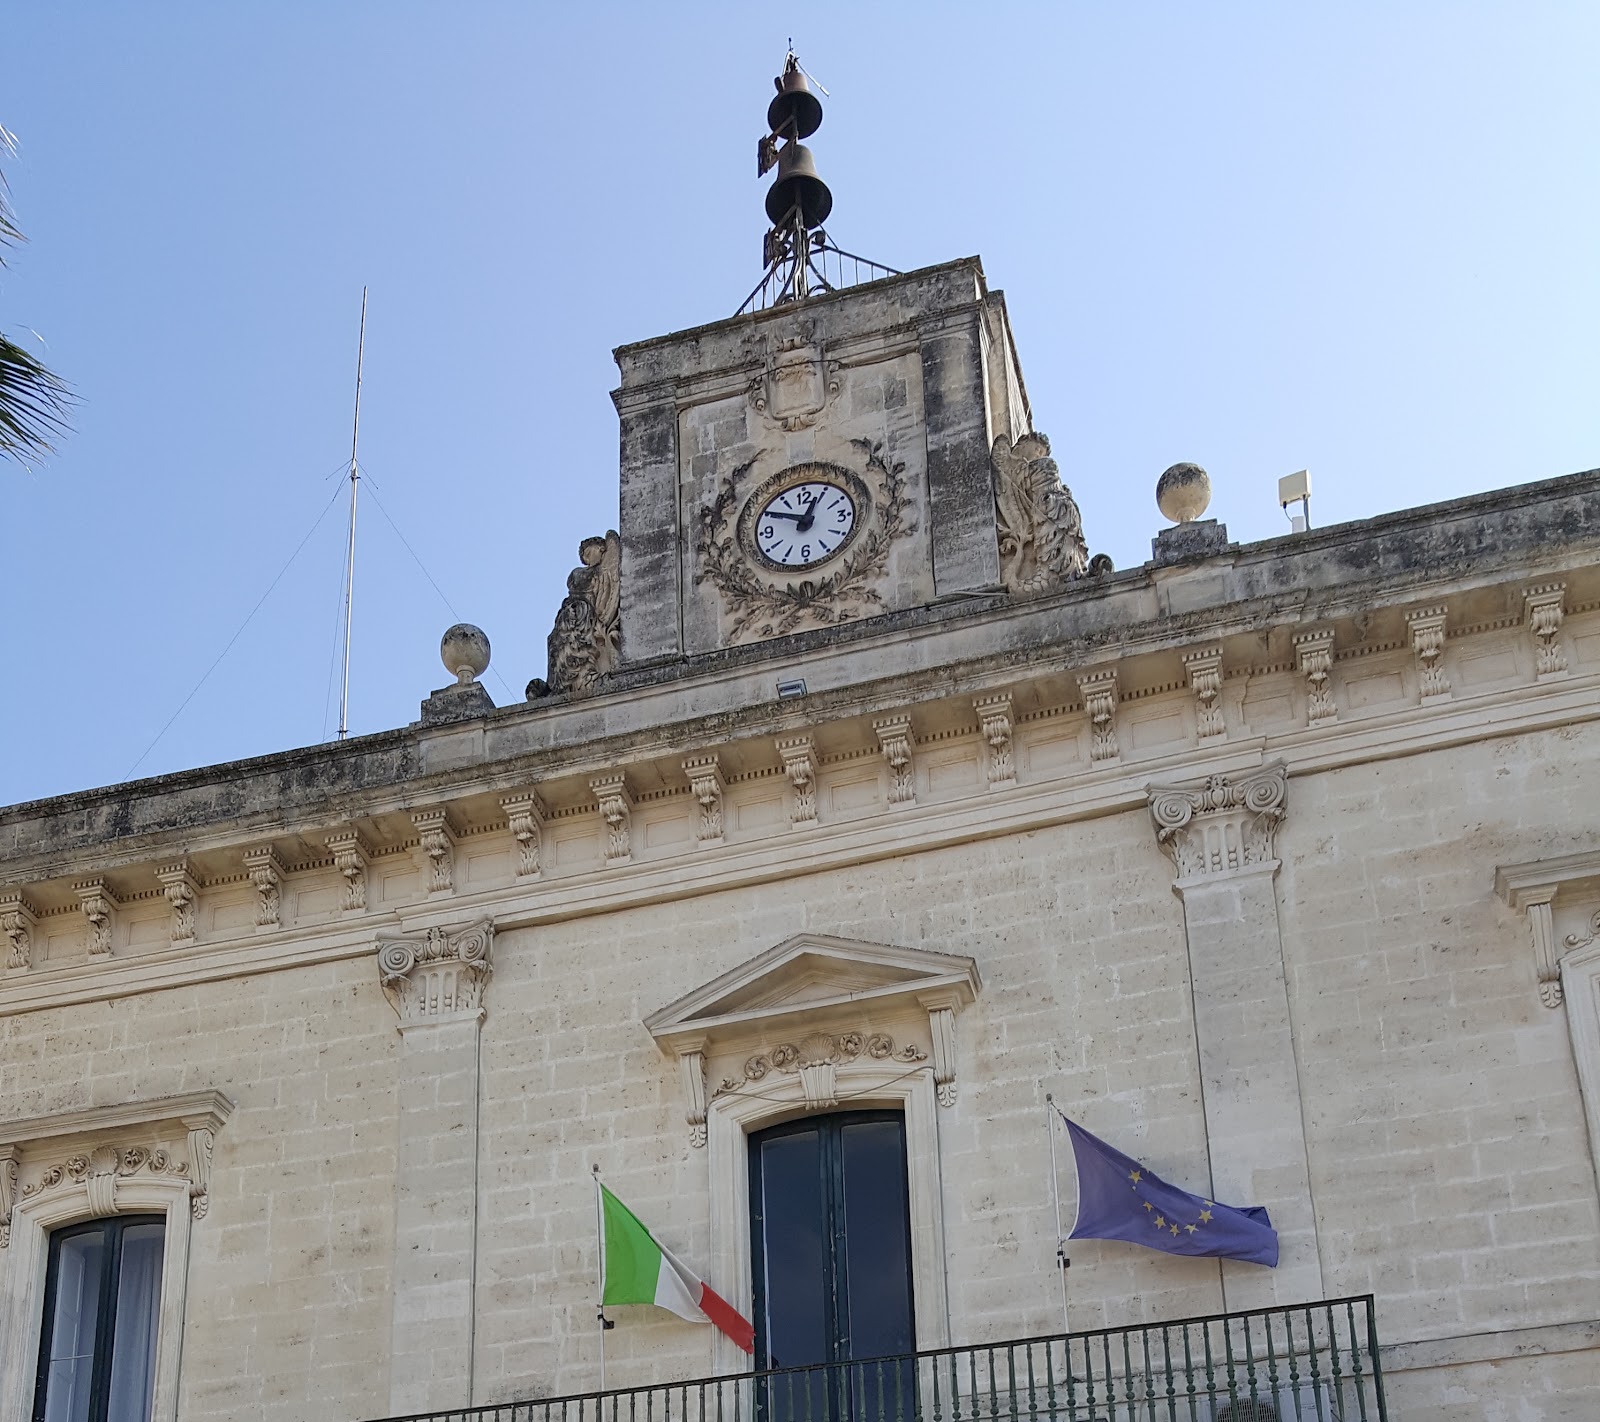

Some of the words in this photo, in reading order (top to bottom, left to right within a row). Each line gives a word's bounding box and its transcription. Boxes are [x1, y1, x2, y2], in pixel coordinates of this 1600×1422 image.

[797, 491, 812, 506] 12
[837, 509, 846, 523] 3
[764, 525, 774, 539] 9
[801, 545, 811, 558] 6
